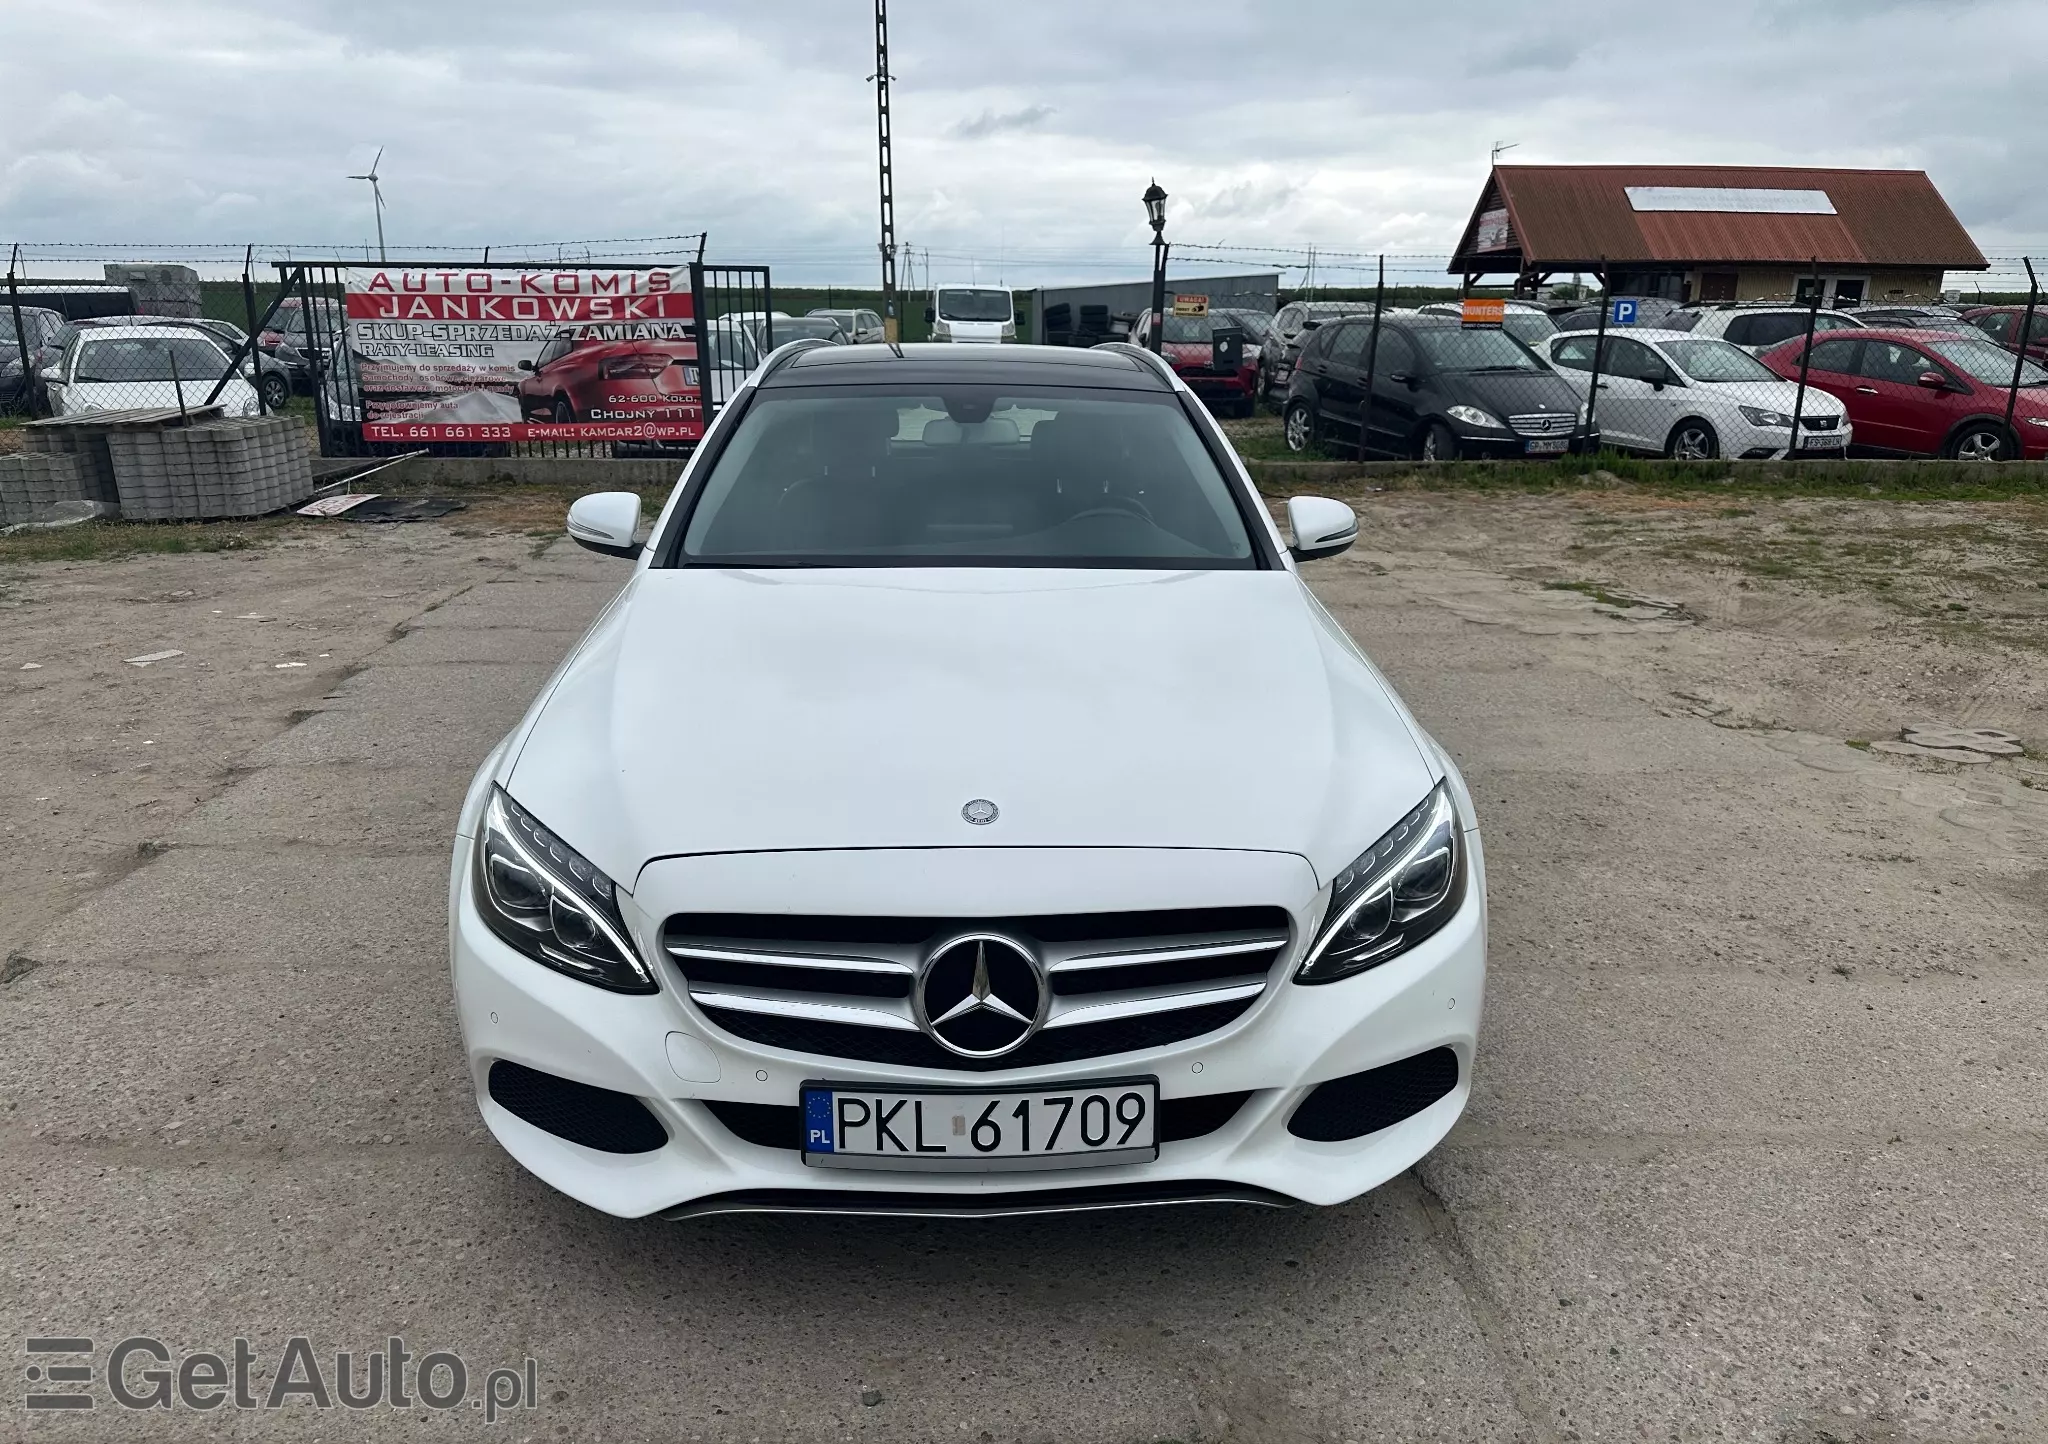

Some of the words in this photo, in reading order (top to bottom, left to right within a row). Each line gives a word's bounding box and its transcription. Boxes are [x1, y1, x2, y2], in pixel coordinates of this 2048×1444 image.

[368, 272, 671, 295] AUTO-KOMIS
[379, 295, 666, 320] JANKOWSKI
[1463, 305, 1504, 316] HUNTERS
[1618, 303, 1633, 321] P
[356, 319, 687, 342] SKUP-SPRZEDAŻ-ZAMIANA
[360, 343, 495, 358] RATY-LEASING
[361, 363, 417, 373] Przyjmujemy
[419, 363, 431, 372] do
[433, 364, 476, 374] sprzedaży
[488, 364, 516, 372] komis
[362, 374, 415, 384] Samochody
[363, 385, 383, 393] oraz
[608, 395, 658, 404] 62-600
[440, 401, 459, 410] auta
[366, 411, 380, 420] do
[382, 411, 425, 421] rejestracji
[590, 408, 656, 419] CHOJNY
[371, 426, 404, 437] TEL.
[409, 426, 437, 437] 661
[445, 426, 473, 437] 661
[481, 426, 511, 437] 333
[527, 427, 576, 438] E-MAIL:
[580, 421, 696, 438] KAMCAR2@WP.PL
[837, 1097, 947, 1153] PKL
[970, 1091, 1147, 1153] 61709
[809, 1129, 831, 1144] PL
